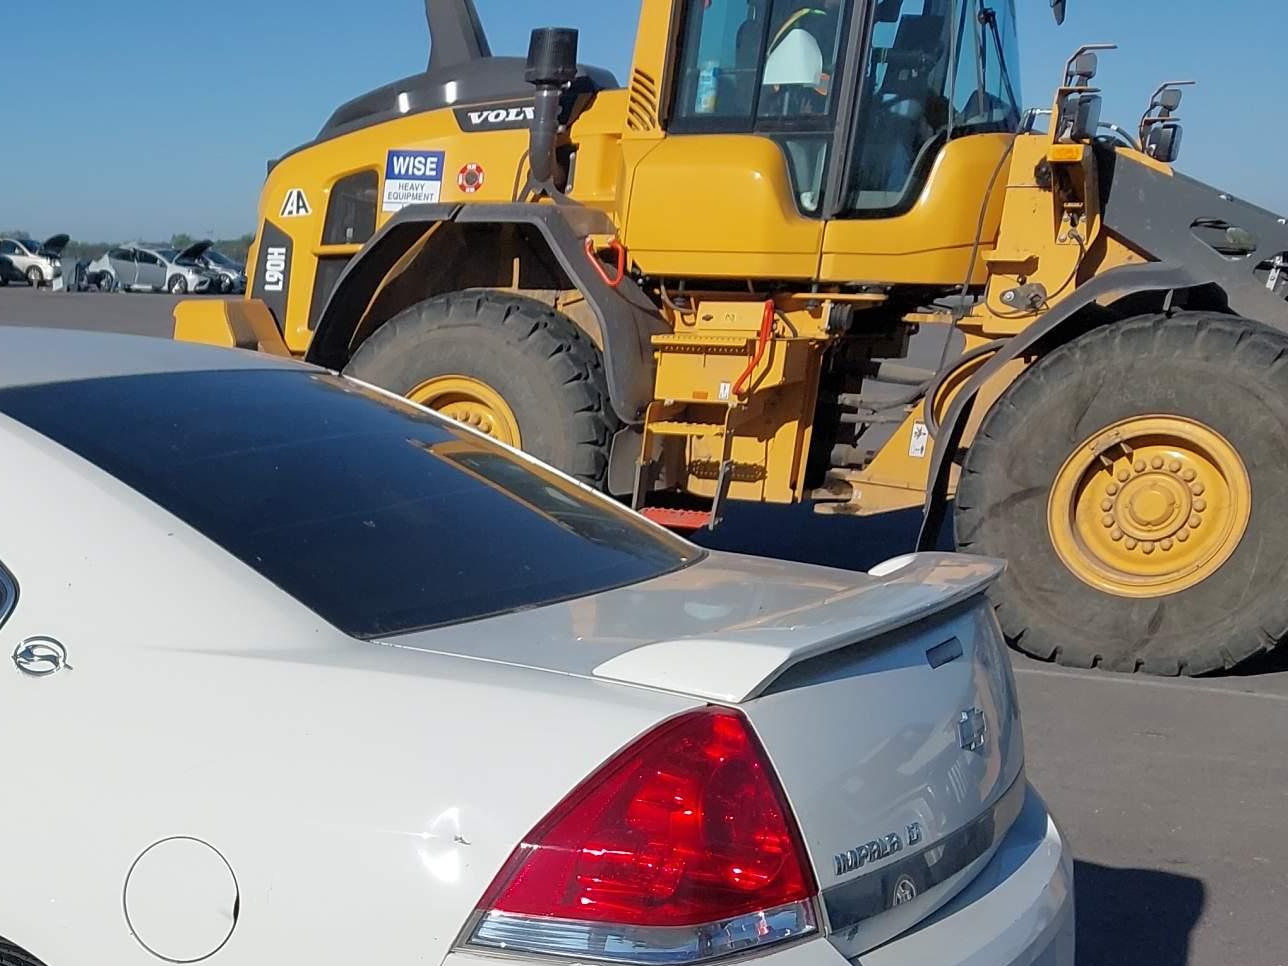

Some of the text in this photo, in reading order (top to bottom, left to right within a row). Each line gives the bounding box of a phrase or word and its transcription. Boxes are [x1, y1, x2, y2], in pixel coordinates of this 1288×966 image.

[393, 155, 438, 176] WISE
[387, 191, 435, 202] EQUIPMENT
[398, 182, 426, 192] HEAVY
[264, 247, 287, 292] L90H
[833, 832, 903, 875] IMPALA
